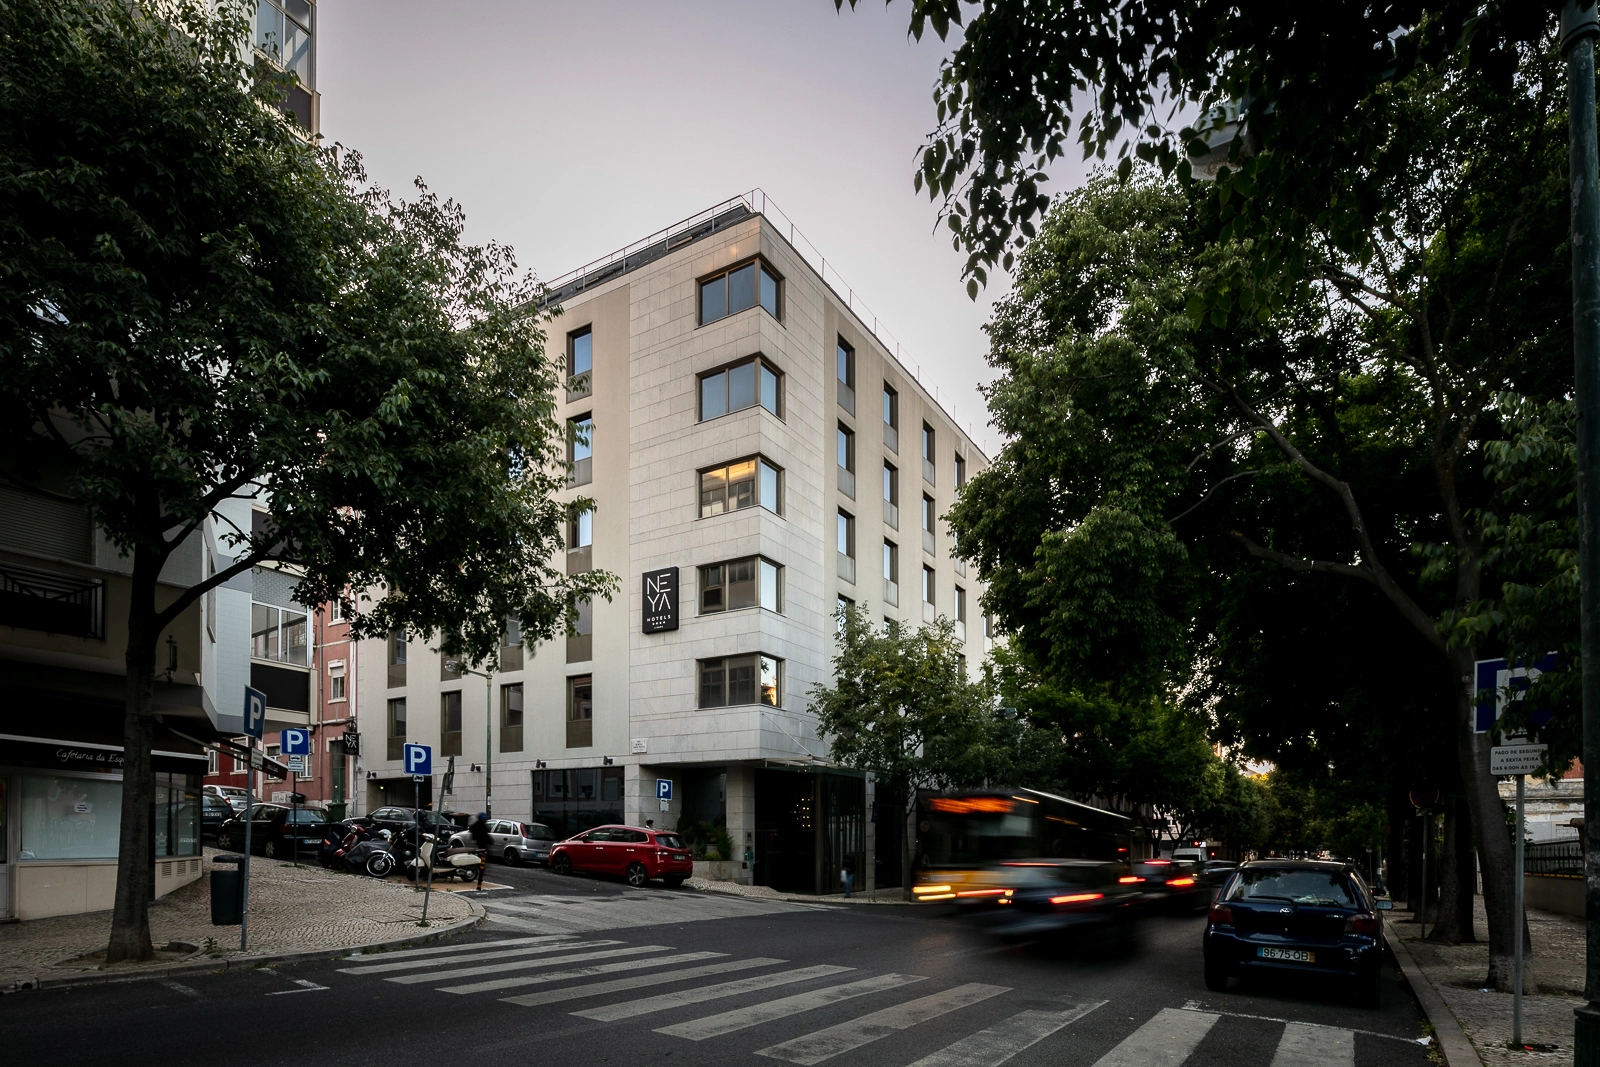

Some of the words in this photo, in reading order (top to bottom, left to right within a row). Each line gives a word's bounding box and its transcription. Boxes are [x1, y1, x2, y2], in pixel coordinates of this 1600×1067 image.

[647, 573, 671, 595] NE
[647, 592, 671, 613] YA
[646, 614, 671, 623] HOTELS
[249, 694, 262, 730] P
[286, 730, 304, 753] P
[55, 748, 94, 763] Cafetaria
[95, 752, 106, 762] da
[410, 746, 427, 772] P
[659, 782, 669, 797] P
[1263, 948, 1309, 961] 96-75-QB
